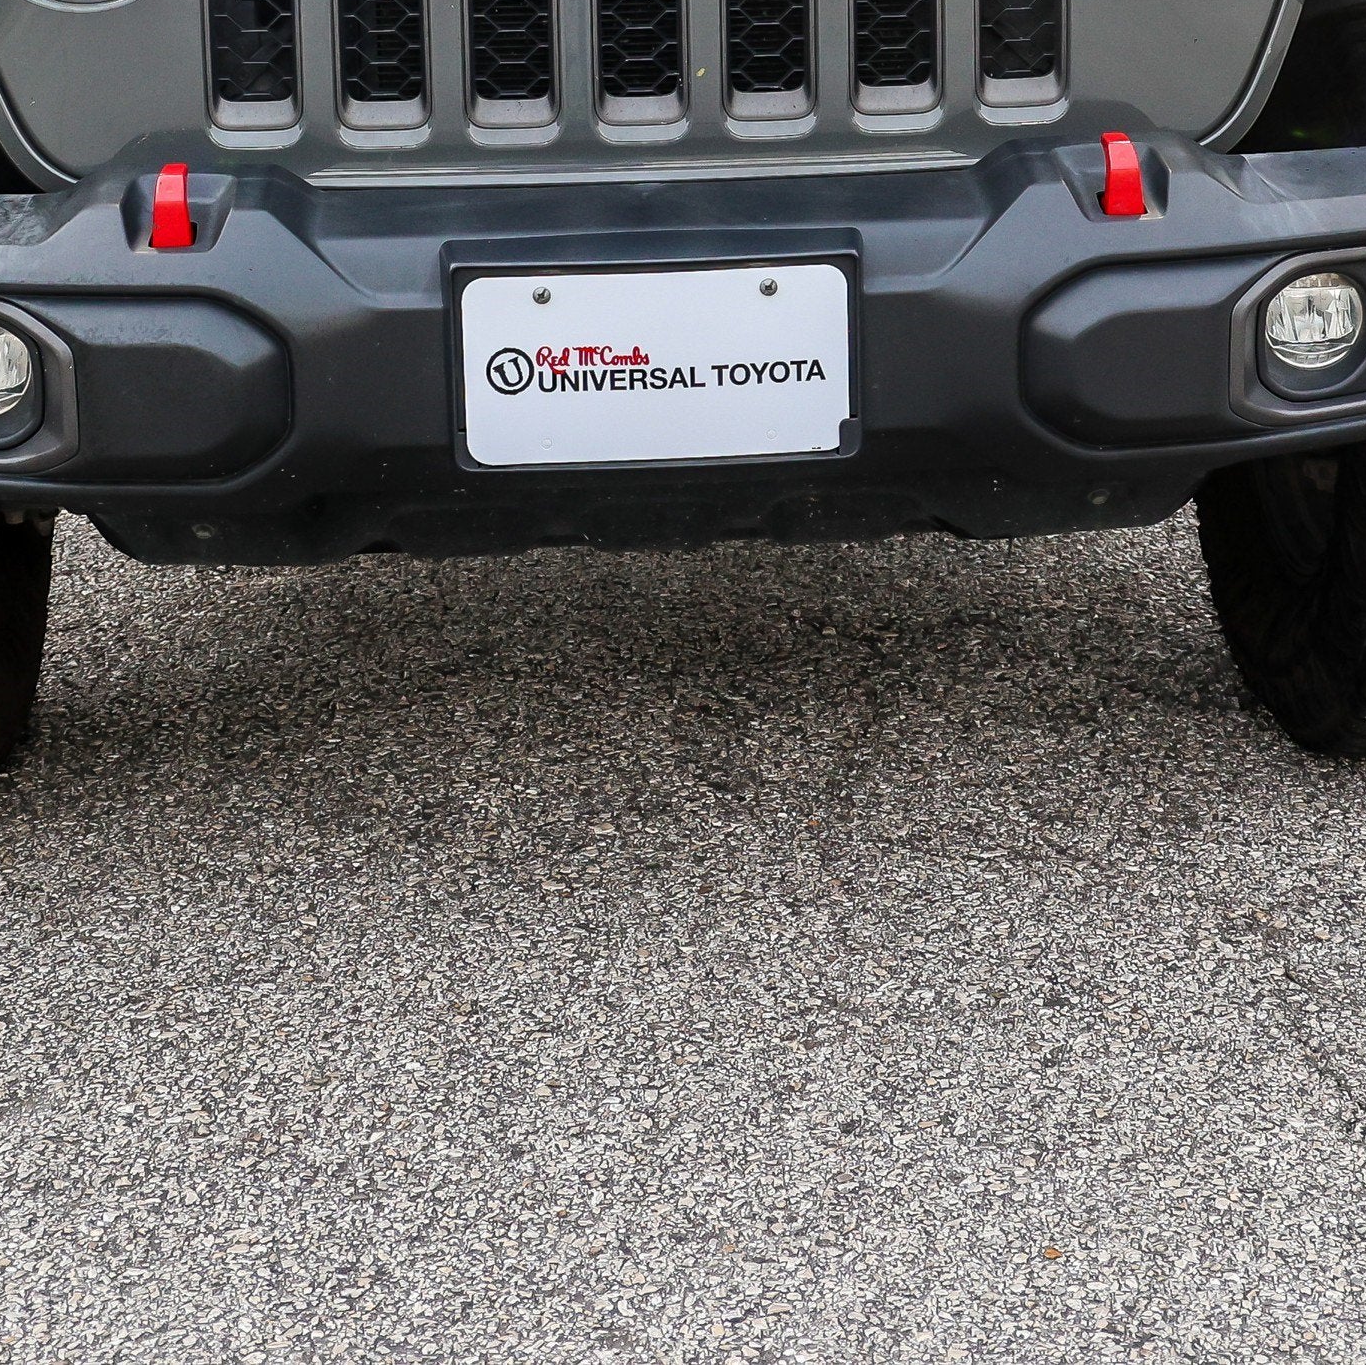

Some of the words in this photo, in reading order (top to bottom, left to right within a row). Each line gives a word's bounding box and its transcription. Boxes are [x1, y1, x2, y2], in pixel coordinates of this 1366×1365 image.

[536, 346, 570, 375] Red
[572, 346, 650, 367] McCombs
[538, 366, 706, 393] UNIVERSAL
[711, 359, 826, 387] TOYOTA
